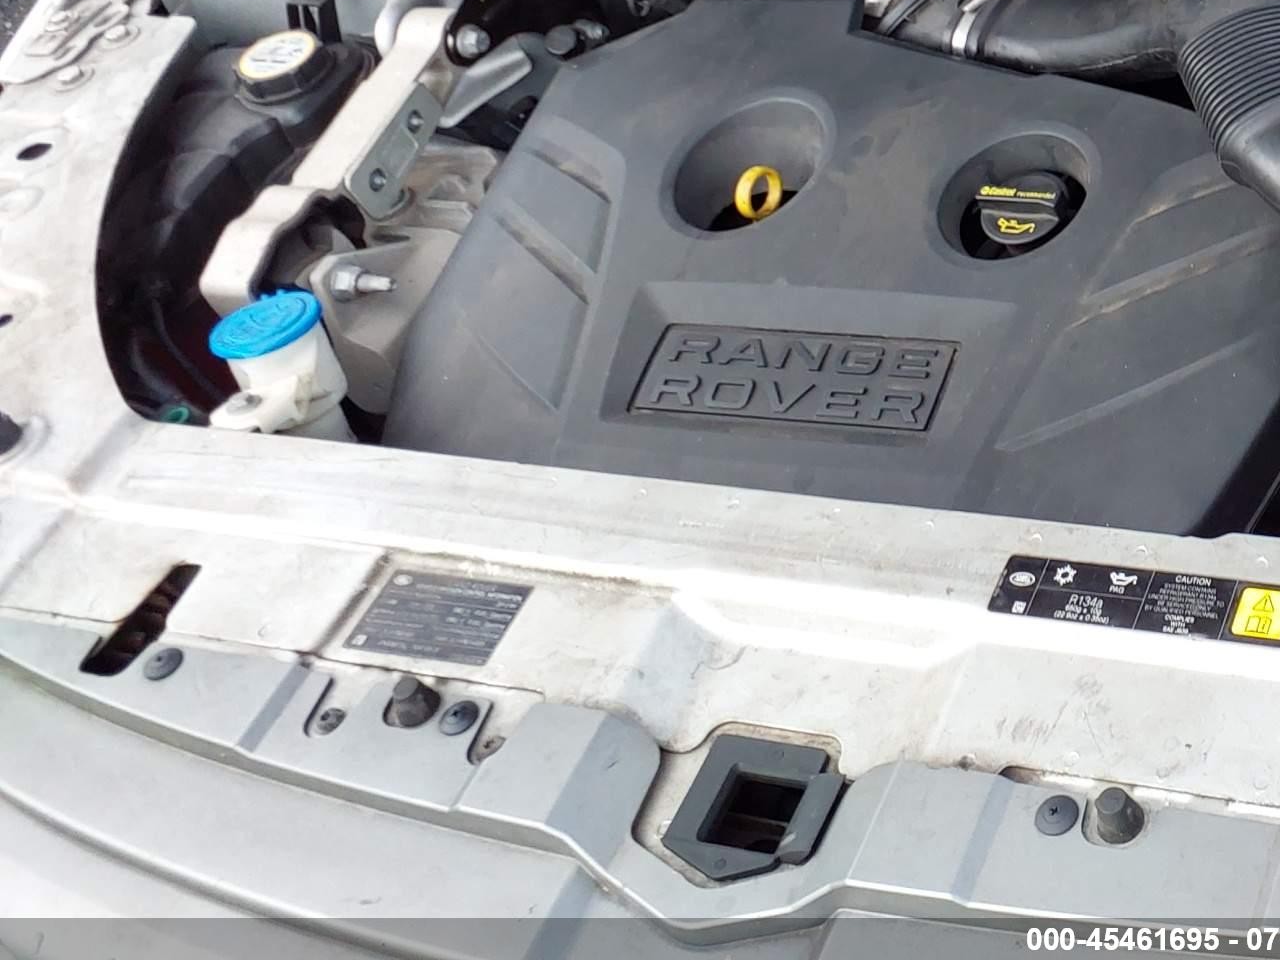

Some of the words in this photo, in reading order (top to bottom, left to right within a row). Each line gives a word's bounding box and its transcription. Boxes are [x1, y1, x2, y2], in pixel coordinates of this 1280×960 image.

[668, 333, 941, 380] RANGE
[651, 374, 929, 424] ROVER
[1175, 575, 1212, 586] CAUTION
[1109, 586, 1125, 594] PAG
[1068, 593, 1104, 609] R134a
